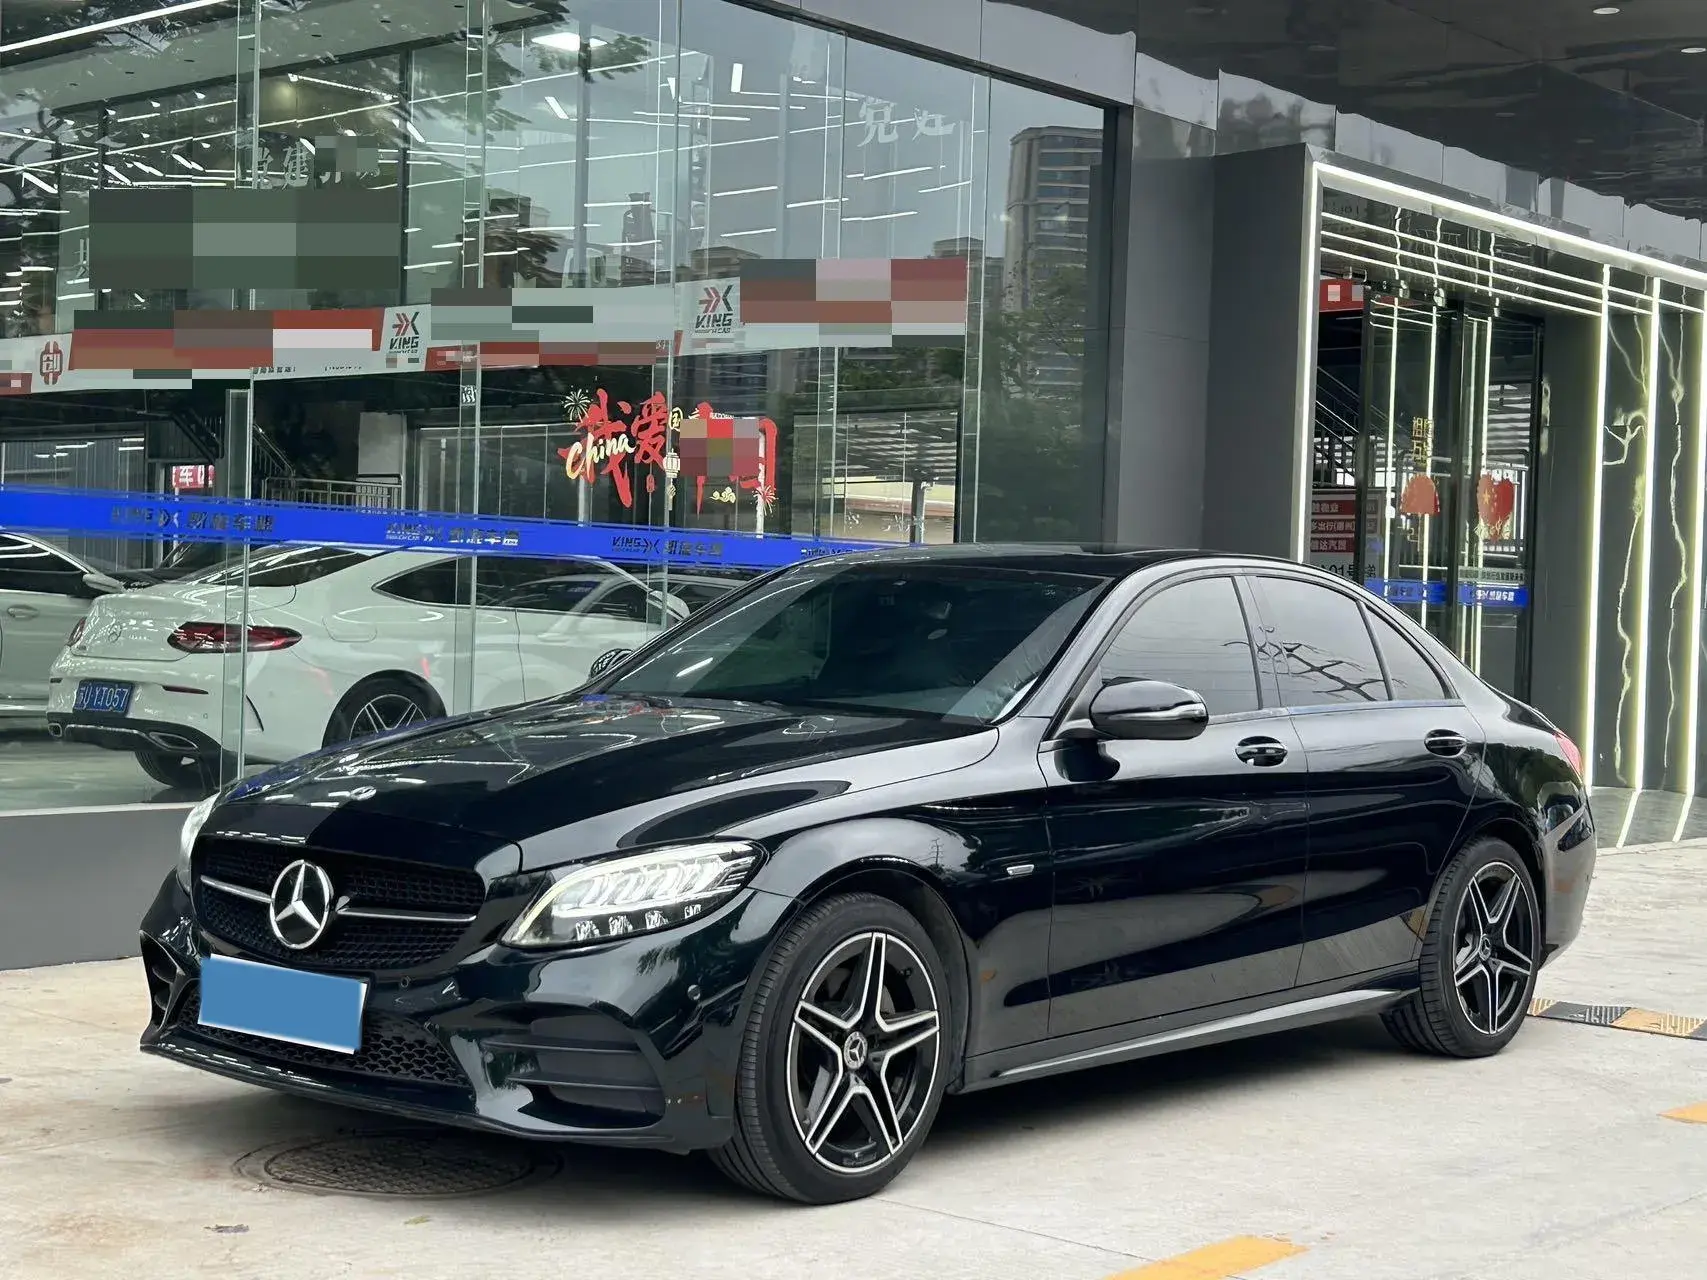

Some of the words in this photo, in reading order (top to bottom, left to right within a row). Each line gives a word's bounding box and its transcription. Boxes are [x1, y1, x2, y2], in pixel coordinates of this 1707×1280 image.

[695, 313, 733, 328] KING
[389, 337, 419, 349] KING
[565, 432, 636, 479] China
